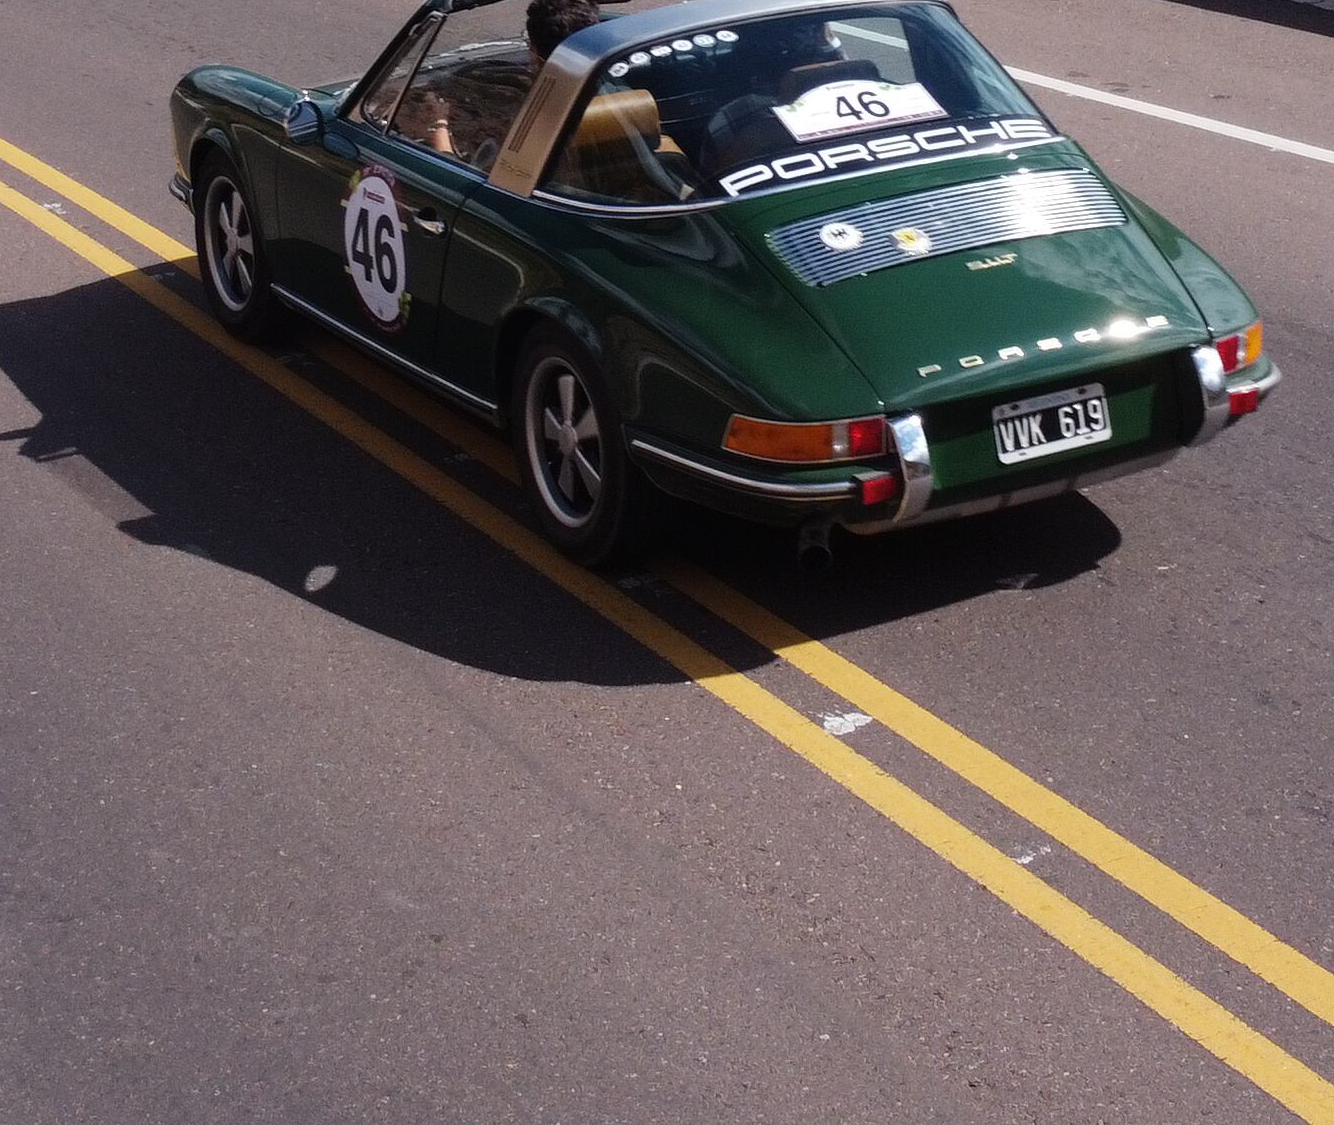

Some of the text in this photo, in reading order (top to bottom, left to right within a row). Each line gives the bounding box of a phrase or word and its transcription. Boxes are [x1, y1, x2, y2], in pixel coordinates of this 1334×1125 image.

[836, 91, 890, 121] 46
[719, 119, 1052, 197] PORSCHE
[351, 207, 399, 294] 46
[917, 315, 1169, 377] PORSCE
[999, 399, 1105, 452] VVK 619
